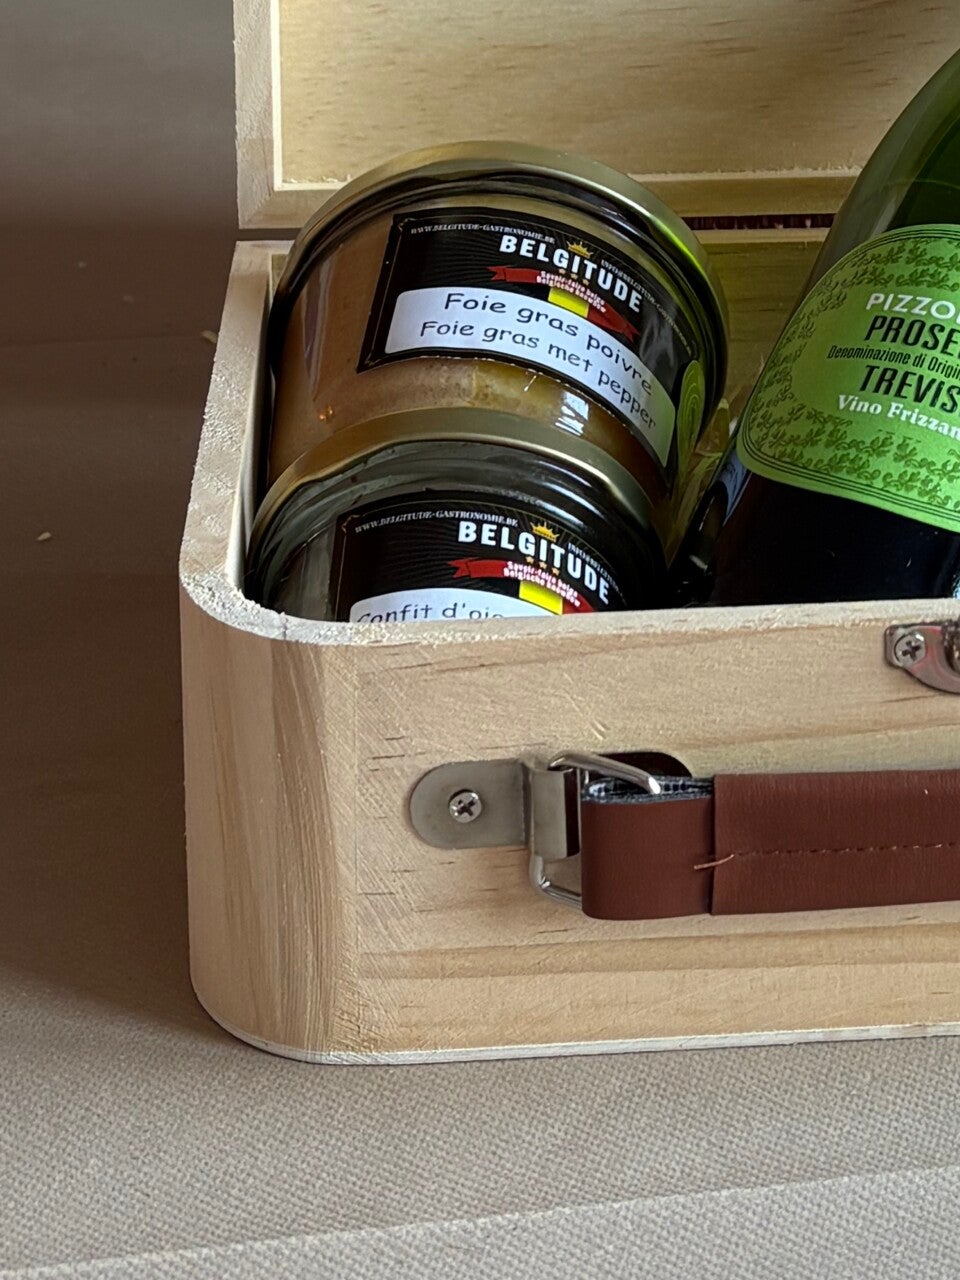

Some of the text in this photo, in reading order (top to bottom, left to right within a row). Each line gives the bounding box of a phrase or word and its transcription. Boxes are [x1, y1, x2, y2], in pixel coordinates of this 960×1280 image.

[499, 234, 643, 313] BELGITUDE
[443, 292, 507, 313] Foie
[516, 307, 579, 338] gras
[420, 320, 657, 429] Foie gras met pepper
[827, 345, 911, 365] Denominazione
[912, 352, 925, 369] di
[838, 394, 882, 416] Vino
[458, 520, 610, 605] BELGITUDE
